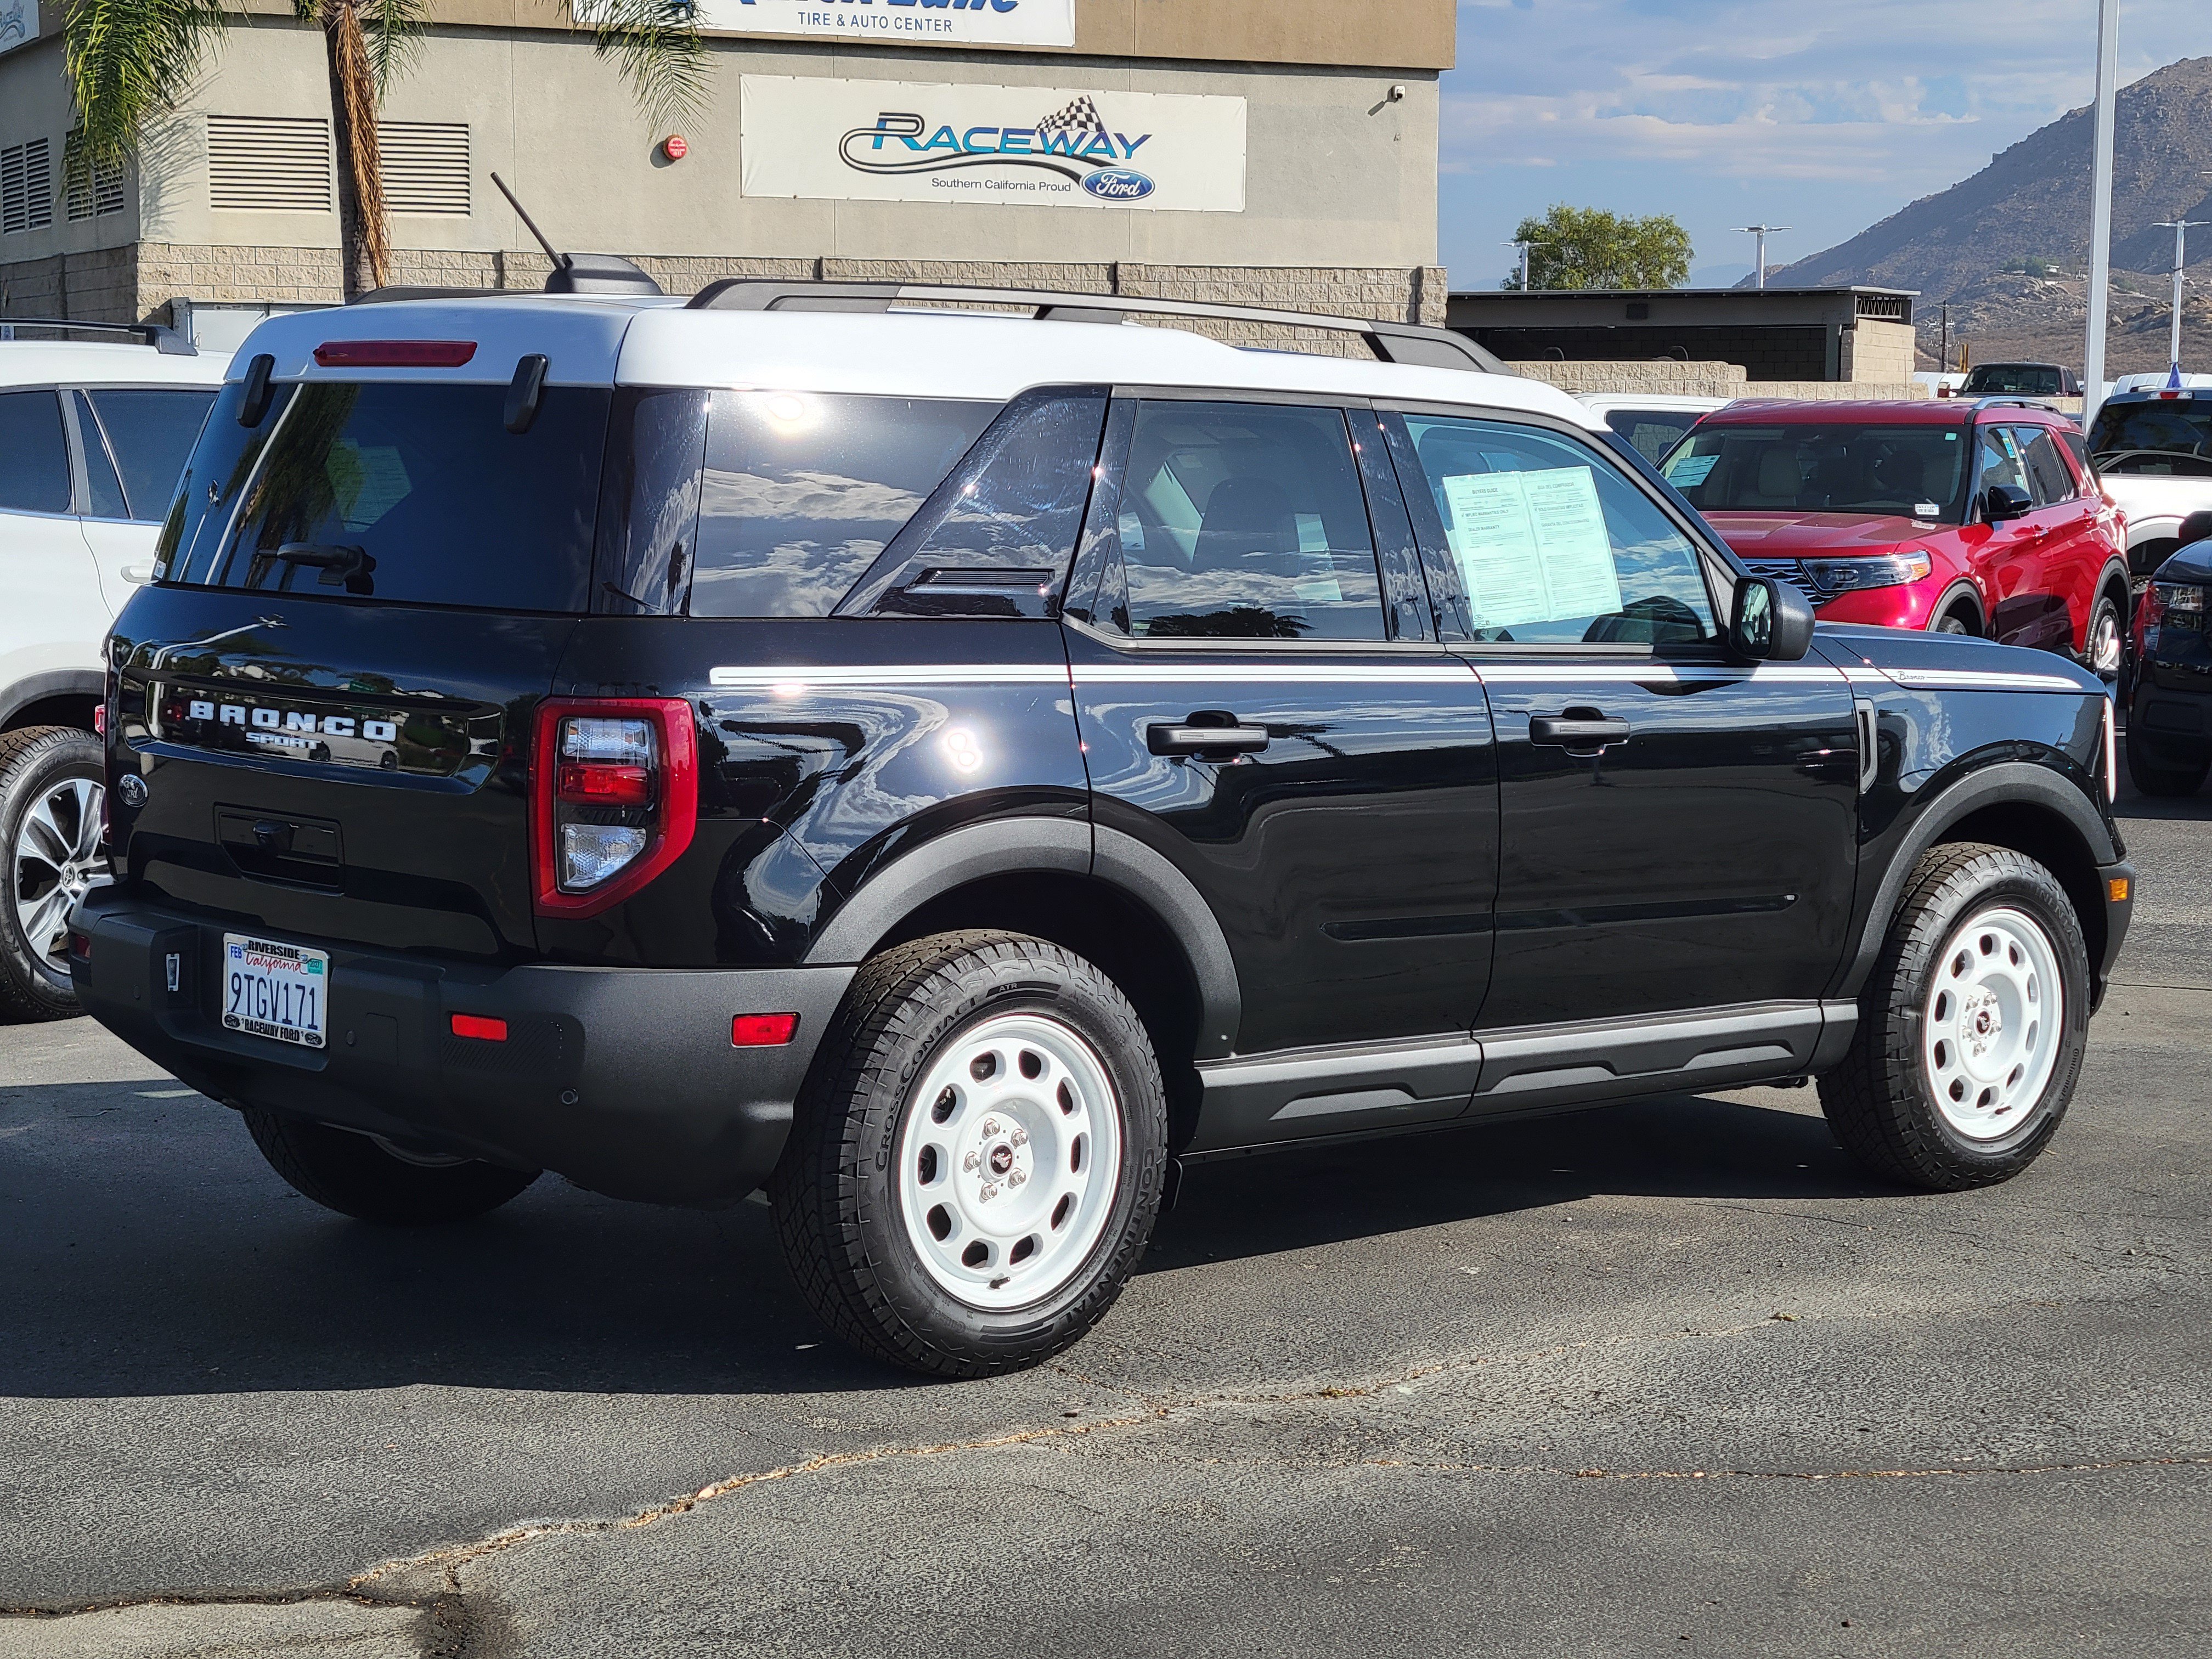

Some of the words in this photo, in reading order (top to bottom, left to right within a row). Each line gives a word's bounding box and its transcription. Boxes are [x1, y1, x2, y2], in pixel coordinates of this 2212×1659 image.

[798, 12, 831, 26] TIRE
[837, 14, 845, 26] &
[850, 15, 888, 29] AUTO
[894, 16, 952, 32] CENTER
[872, 111, 1153, 159] RACEWAY
[932, 177, 982, 190] Southern
[985, 179, 1036, 191] California
[1039, 182, 1071, 192] Proud
[1096, 173, 1141, 196] Ford
[1897, 671, 1925, 680] Bronco
[190, 700, 397, 741] BRONCO
[245, 732, 322, 750] SPORT
[230, 945, 242, 959] FEB
[248, 940, 300, 960] RIVERSIDE
[246, 952, 308, 975] California
[998, 983, 1018, 992] ATR
[231, 972, 318, 1030] 9TGV171
[245, 1018, 279, 1037] RACEWAY
[280, 1027, 300, 1042] FORD
[2061, 1047, 2079, 1097] Continental
[1058, 1148, 1155, 1323] CONTINENTAL
